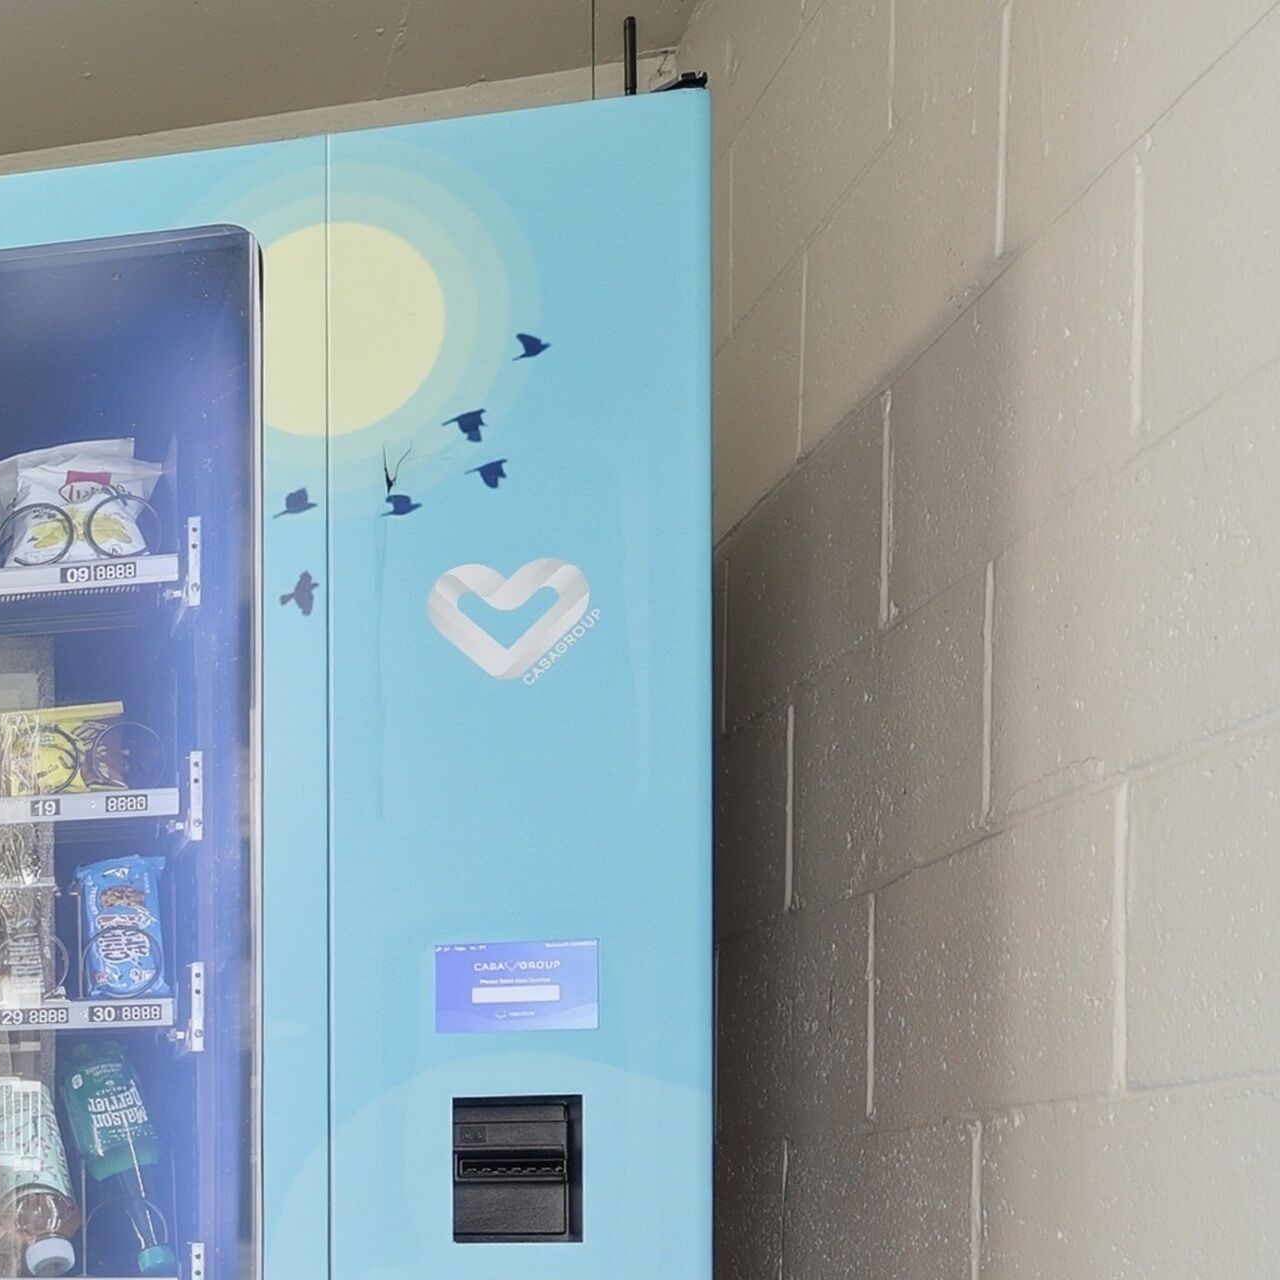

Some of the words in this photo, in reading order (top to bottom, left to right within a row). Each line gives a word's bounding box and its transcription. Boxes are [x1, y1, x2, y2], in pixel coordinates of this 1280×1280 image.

[66, 568, 89, 583] 09
[523, 606, 602, 685] CASAGROUP
[34, 800, 56, 816] 19
[519, 960, 561, 969] GROUP
[2, 1011, 23, 1025] 29
[93, 1008, 115, 1022] 30
